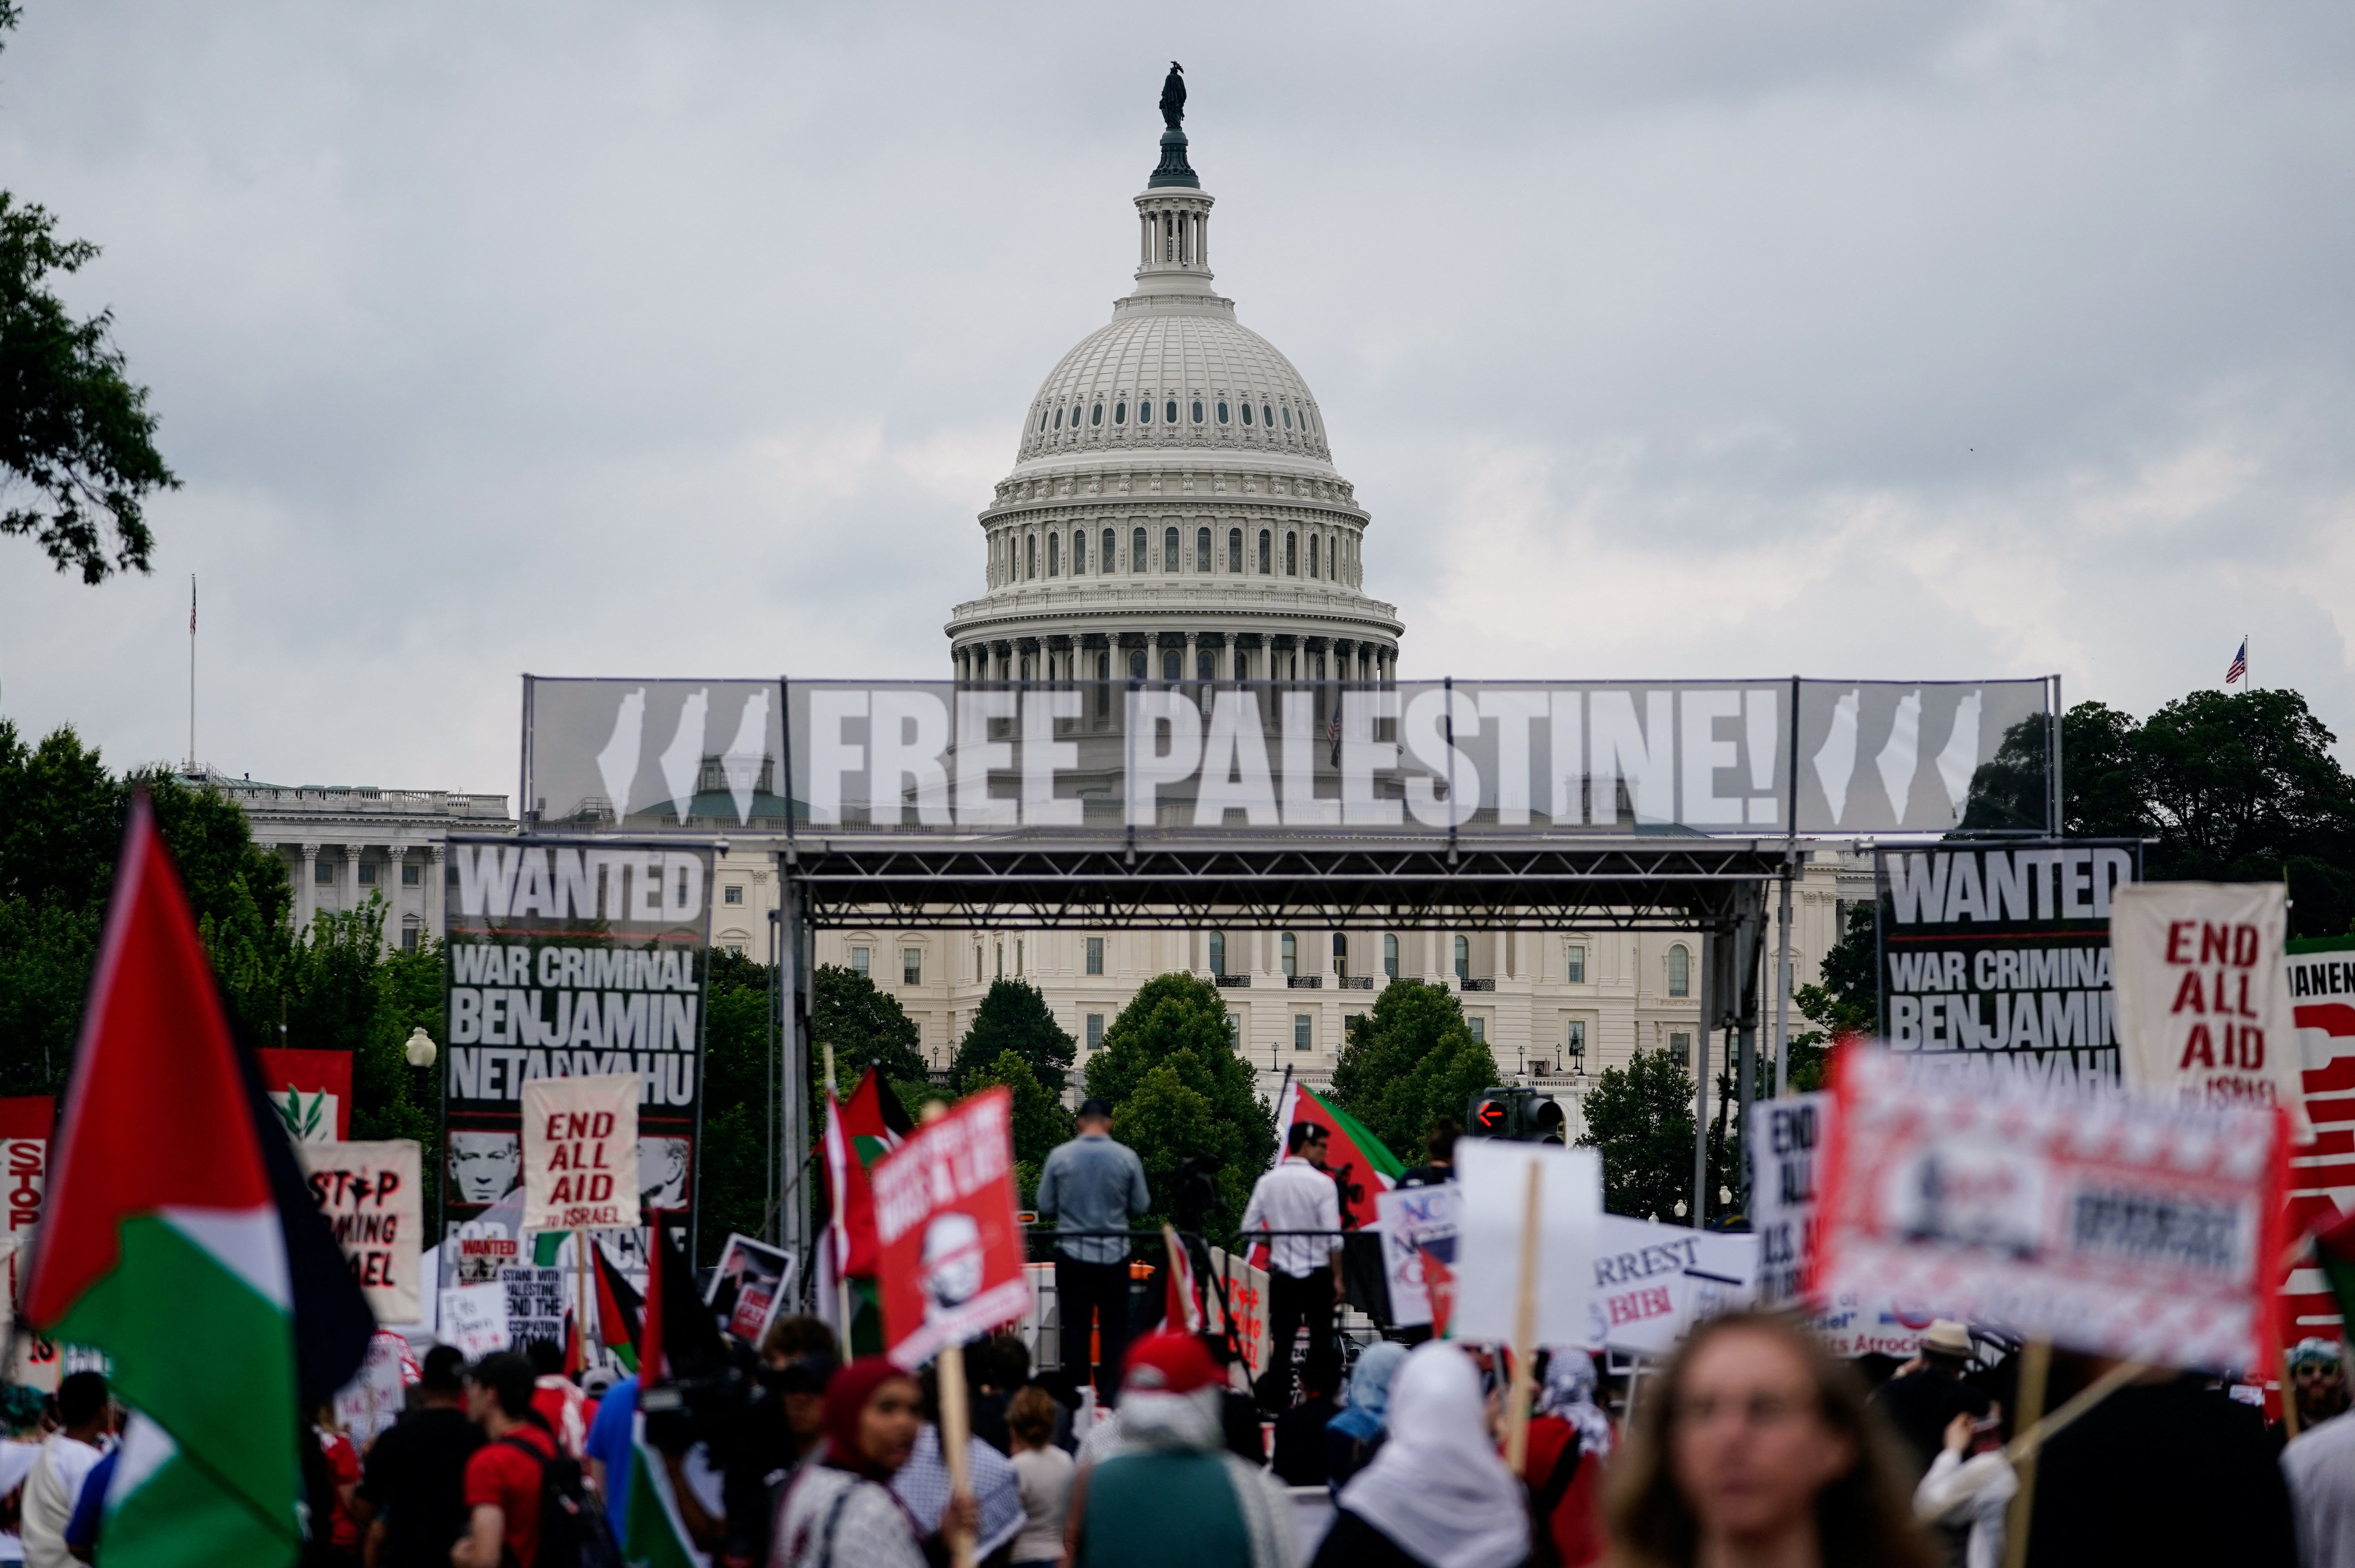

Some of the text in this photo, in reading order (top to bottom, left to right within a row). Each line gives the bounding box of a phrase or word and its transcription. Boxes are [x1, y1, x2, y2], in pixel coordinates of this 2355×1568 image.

[809, 688, 1778, 827] FREE PALESTINE!
[457, 845, 704, 922] WANTED
[1885, 848, 2132, 924] WANTED
[452, 944, 699, 991] WAR CRIMINAL
[2165, 920, 2259, 968] END
[1888, 947, 2115, 992] WAR CRIMINA
[2287, 962, 2355, 998] ANEN
[2171, 969, 2258, 1020] ALL
[449, 987, 698, 1051] BENJAMIN
[1890, 990, 2121, 1051] BENJAMIN
[2179, 1022, 2265, 1071] AID
[546, 1111, 615, 1141] END
[548, 1141, 610, 1171] ALL
[8, 1143, 42, 1231] STOP
[549, 1173, 614, 1205] AID
[563, 1204, 620, 1227] ISRAEL
[461, 1239, 518, 1255] WANTED
[1593, 1235, 1701, 1287] RREST
[537, 1269, 561, 1282] WITH
[537, 1297, 561, 1317] THE
[1606, 1285, 1673, 1328] BIBI
